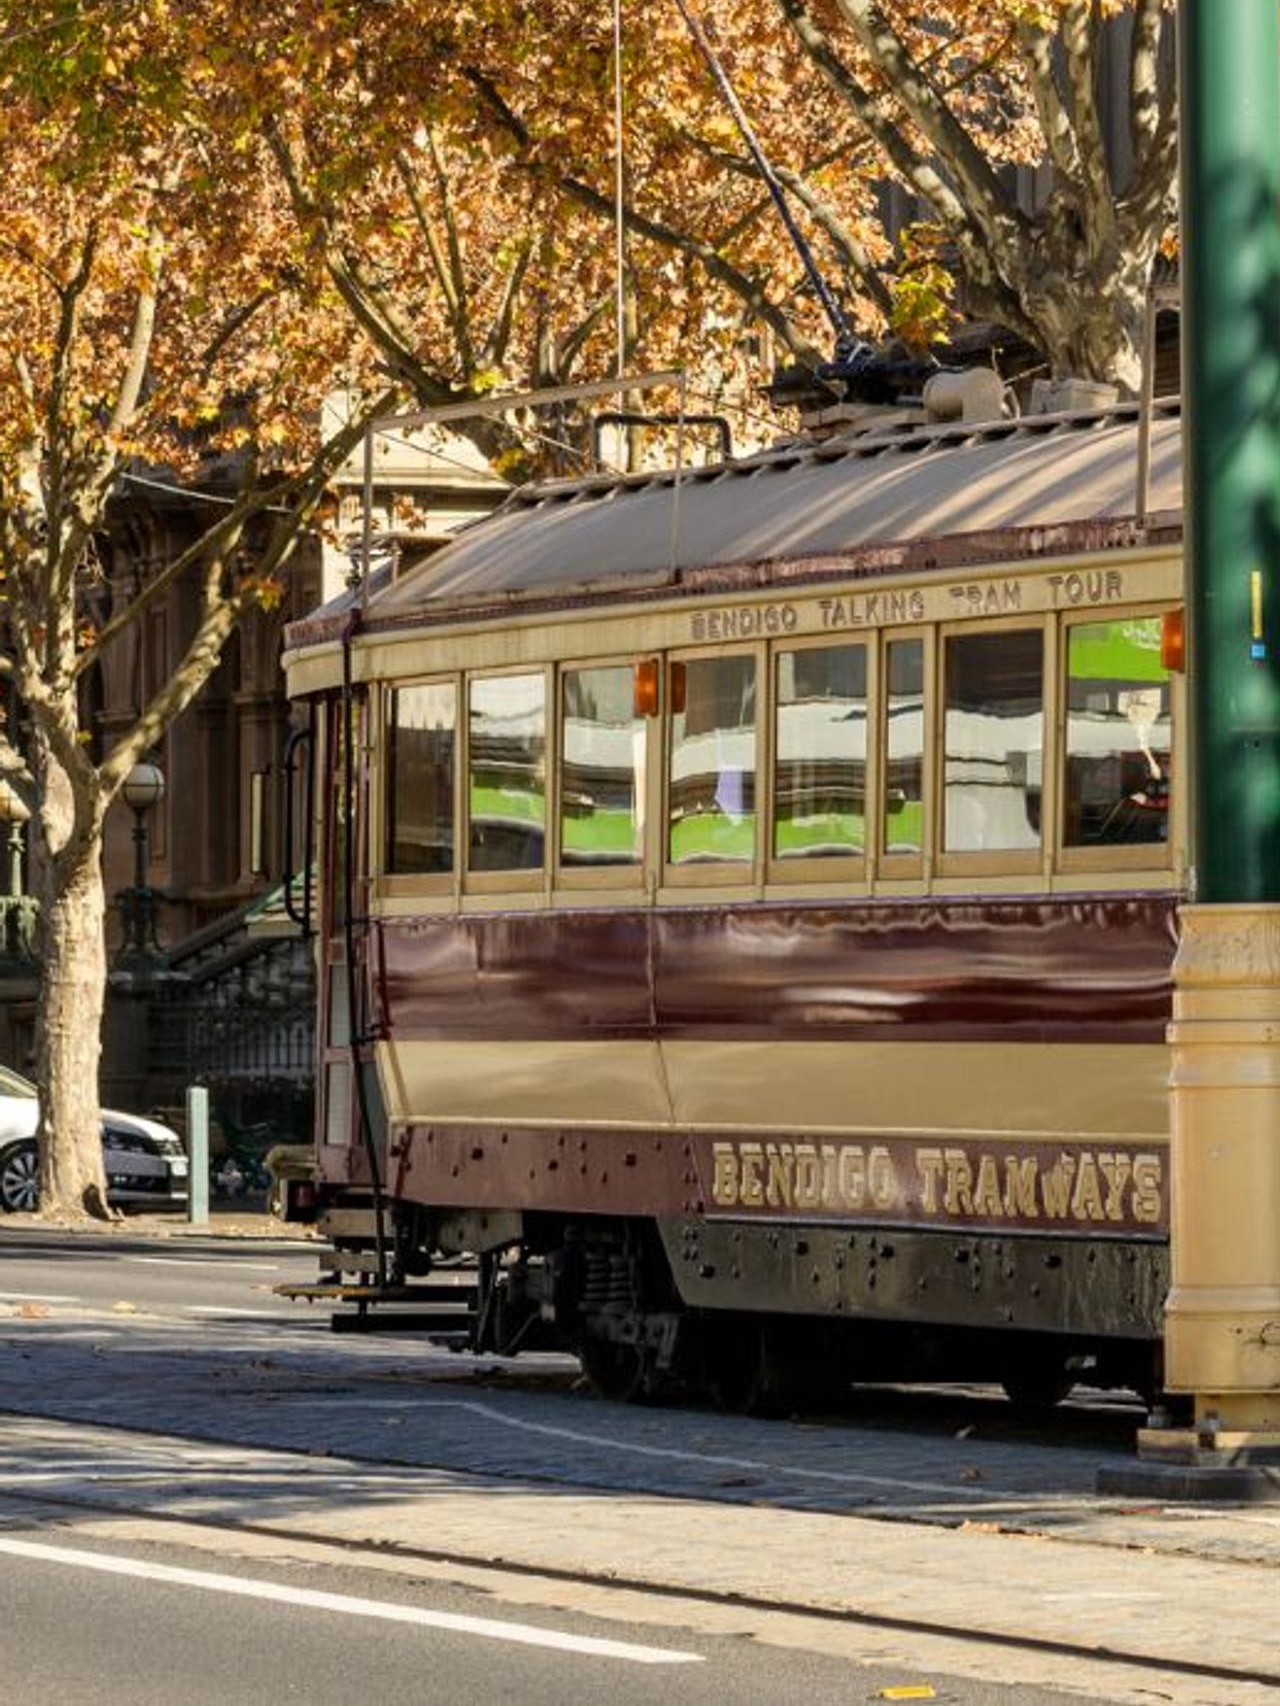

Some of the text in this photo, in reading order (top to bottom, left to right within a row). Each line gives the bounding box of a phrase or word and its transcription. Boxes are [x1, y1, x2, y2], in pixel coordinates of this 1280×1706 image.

[691, 570, 1123, 640] BENDIGO TALKING TRAM TOUR
[712, 1142, 1162, 1223] BENDIGO TRAMWAYS
